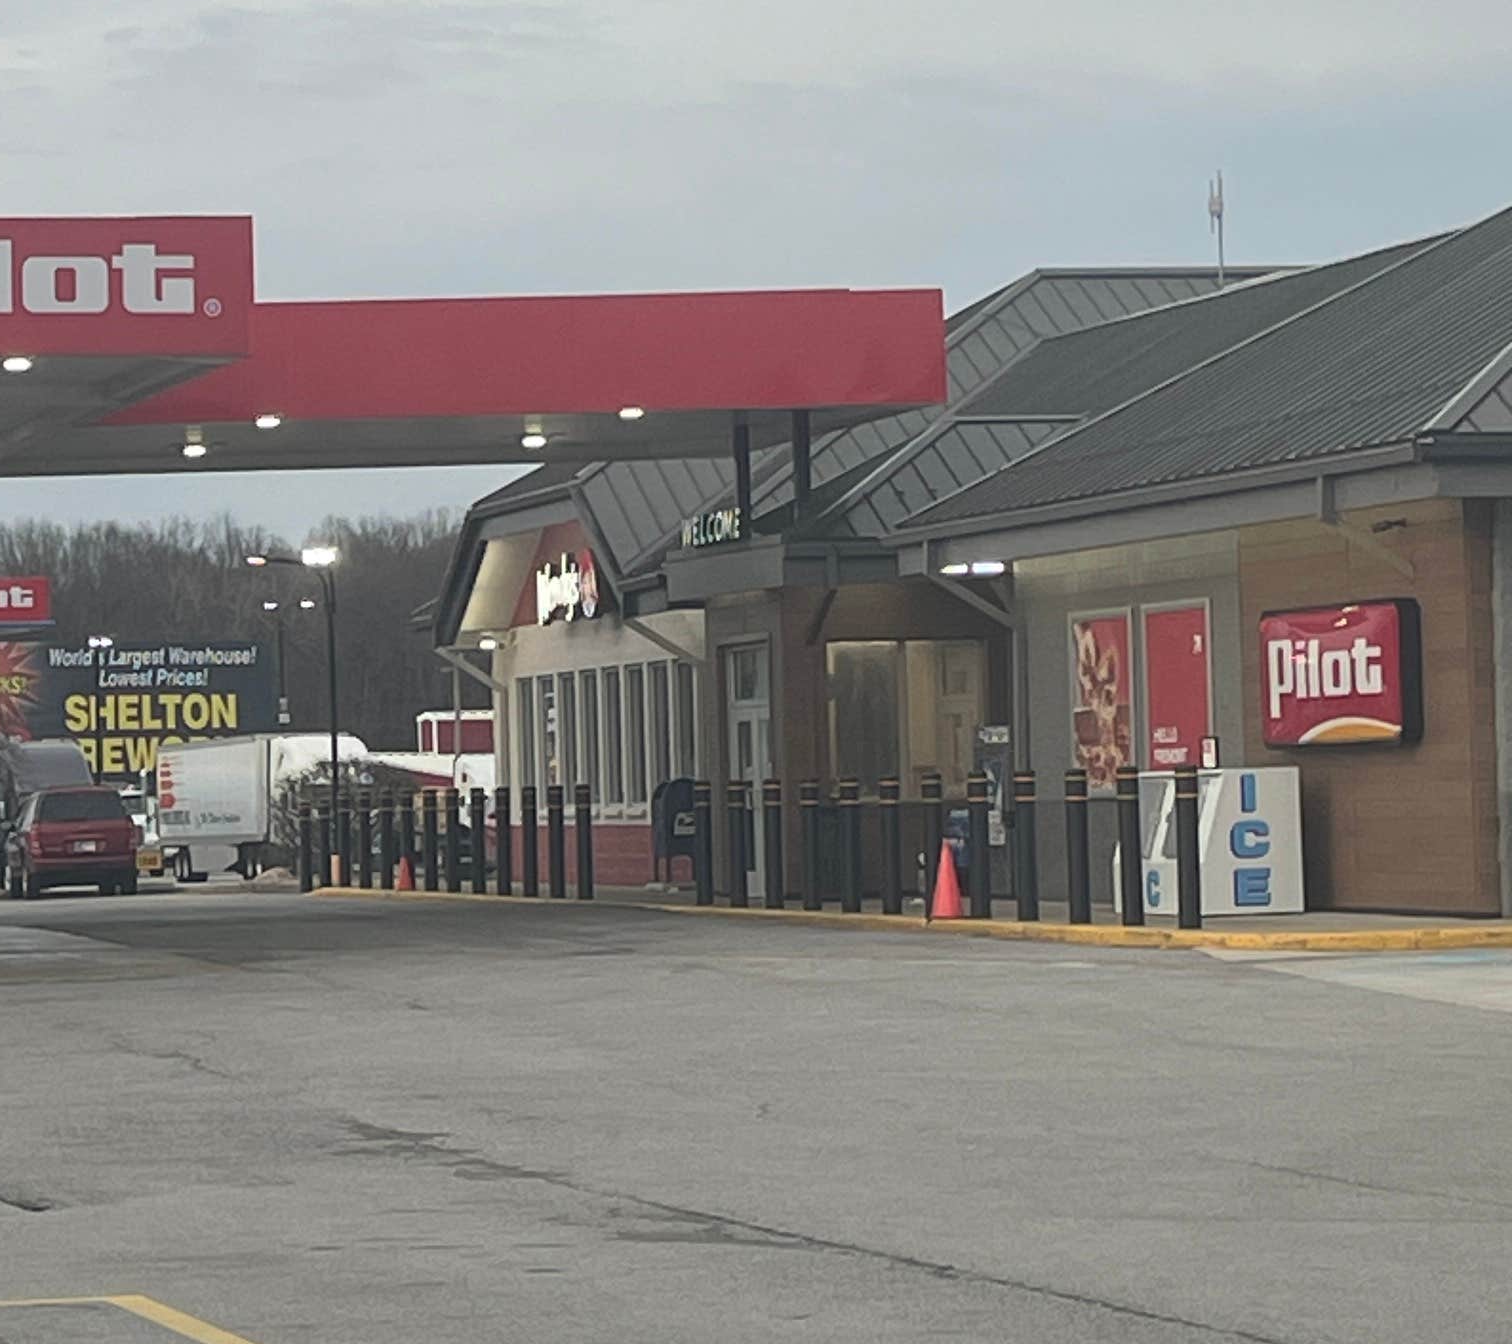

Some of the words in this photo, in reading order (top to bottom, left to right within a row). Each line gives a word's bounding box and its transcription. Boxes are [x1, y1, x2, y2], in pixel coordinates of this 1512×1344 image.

[682, 508, 741, 546] WELCOME
[99, 669, 153, 686] Lowest
[156, 668, 209, 686] Prices!
[109, 647, 165, 671] Largest
[168, 645, 257, 666] Warehouse!
[1267, 638, 1384, 719] Pilot
[64, 693, 237, 732] SHELTON
[1230, 773, 1272, 907] ICE
